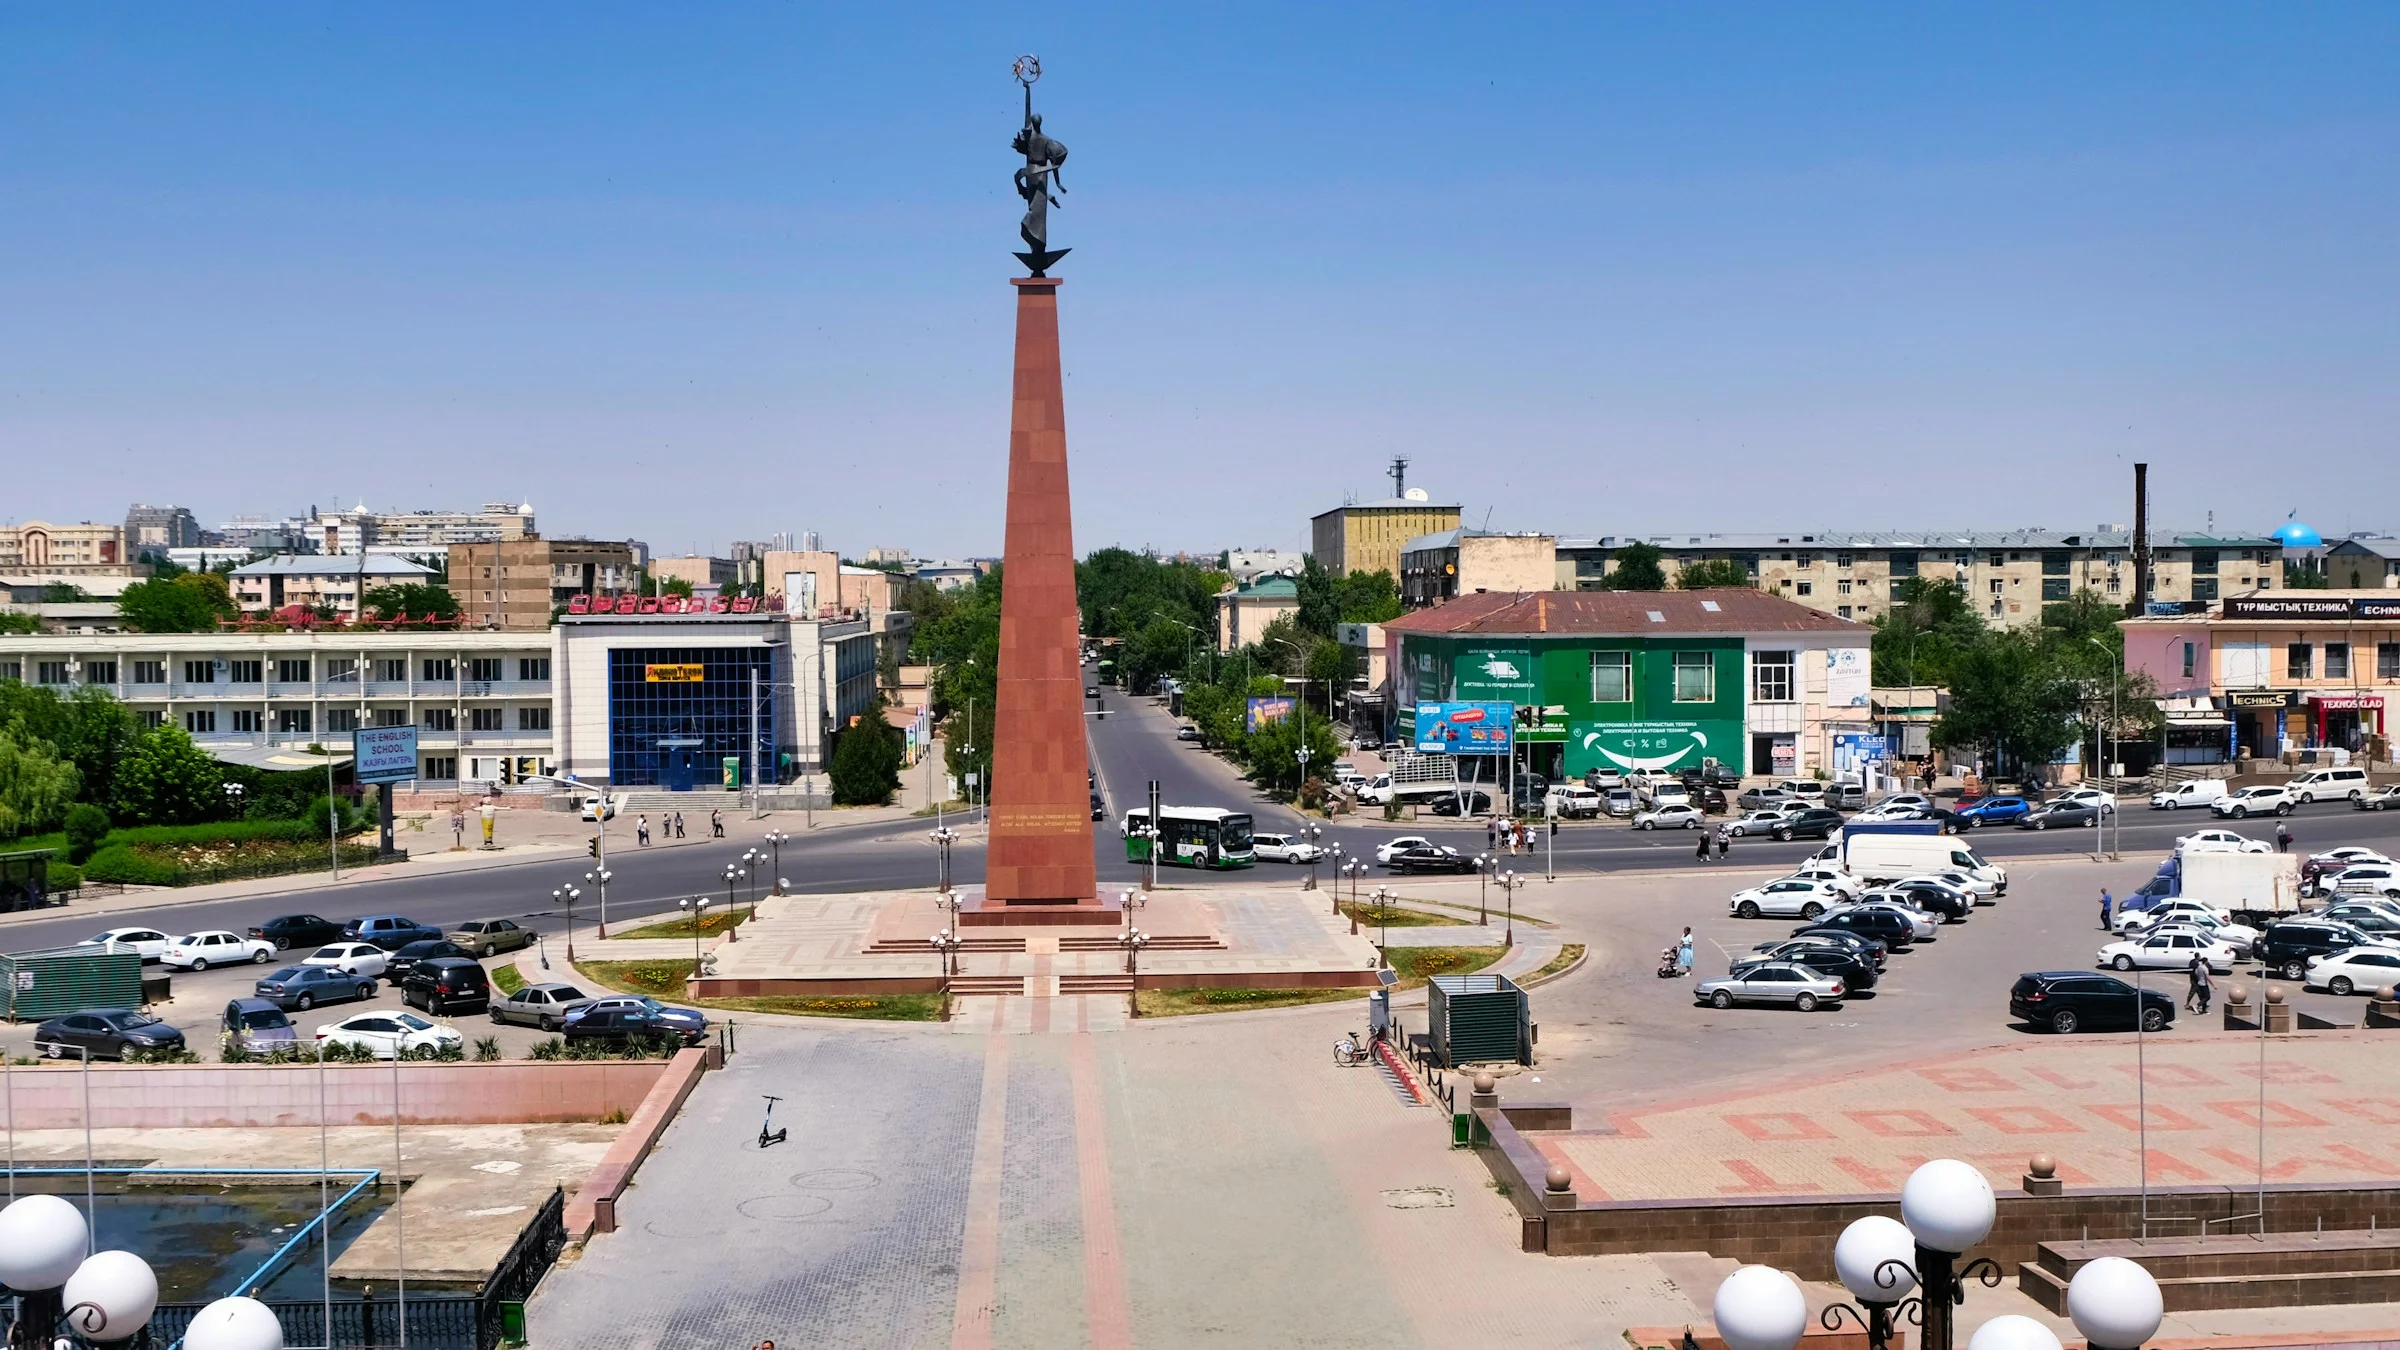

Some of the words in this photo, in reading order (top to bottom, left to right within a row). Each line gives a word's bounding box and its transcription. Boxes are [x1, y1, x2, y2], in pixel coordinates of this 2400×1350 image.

[2302, 602, 2348, 612] ТЕХНИКА
[361, 733, 376, 743] THE
[378, 731, 412, 742] ENGLISH
[371, 743, 404, 755] SCHOOL
[387, 755, 413, 765] ЛАГЕРЬ
